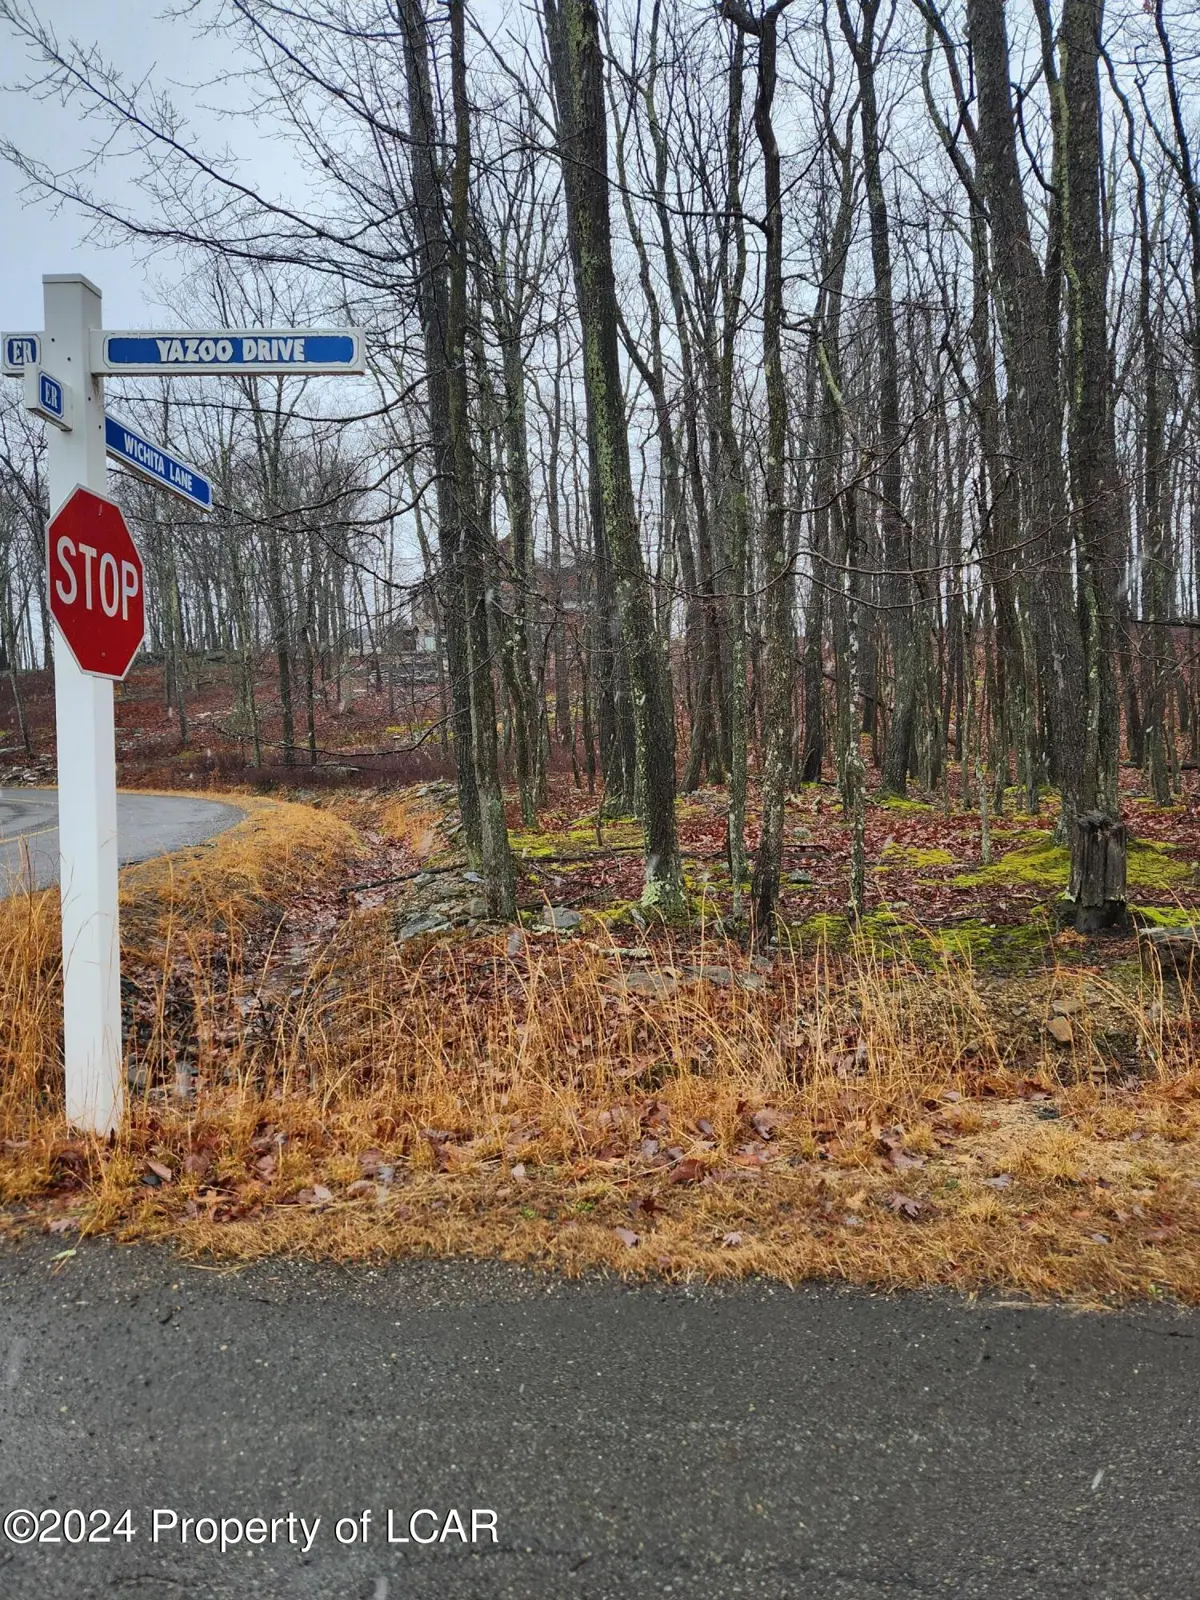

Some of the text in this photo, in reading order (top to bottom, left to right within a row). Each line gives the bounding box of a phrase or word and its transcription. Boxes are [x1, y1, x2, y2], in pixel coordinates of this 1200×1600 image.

[156, 338, 305, 362] YAZOO DRIVE
[124, 432, 193, 491] WICHITA LANE
[55, 535, 139, 621] STOP
